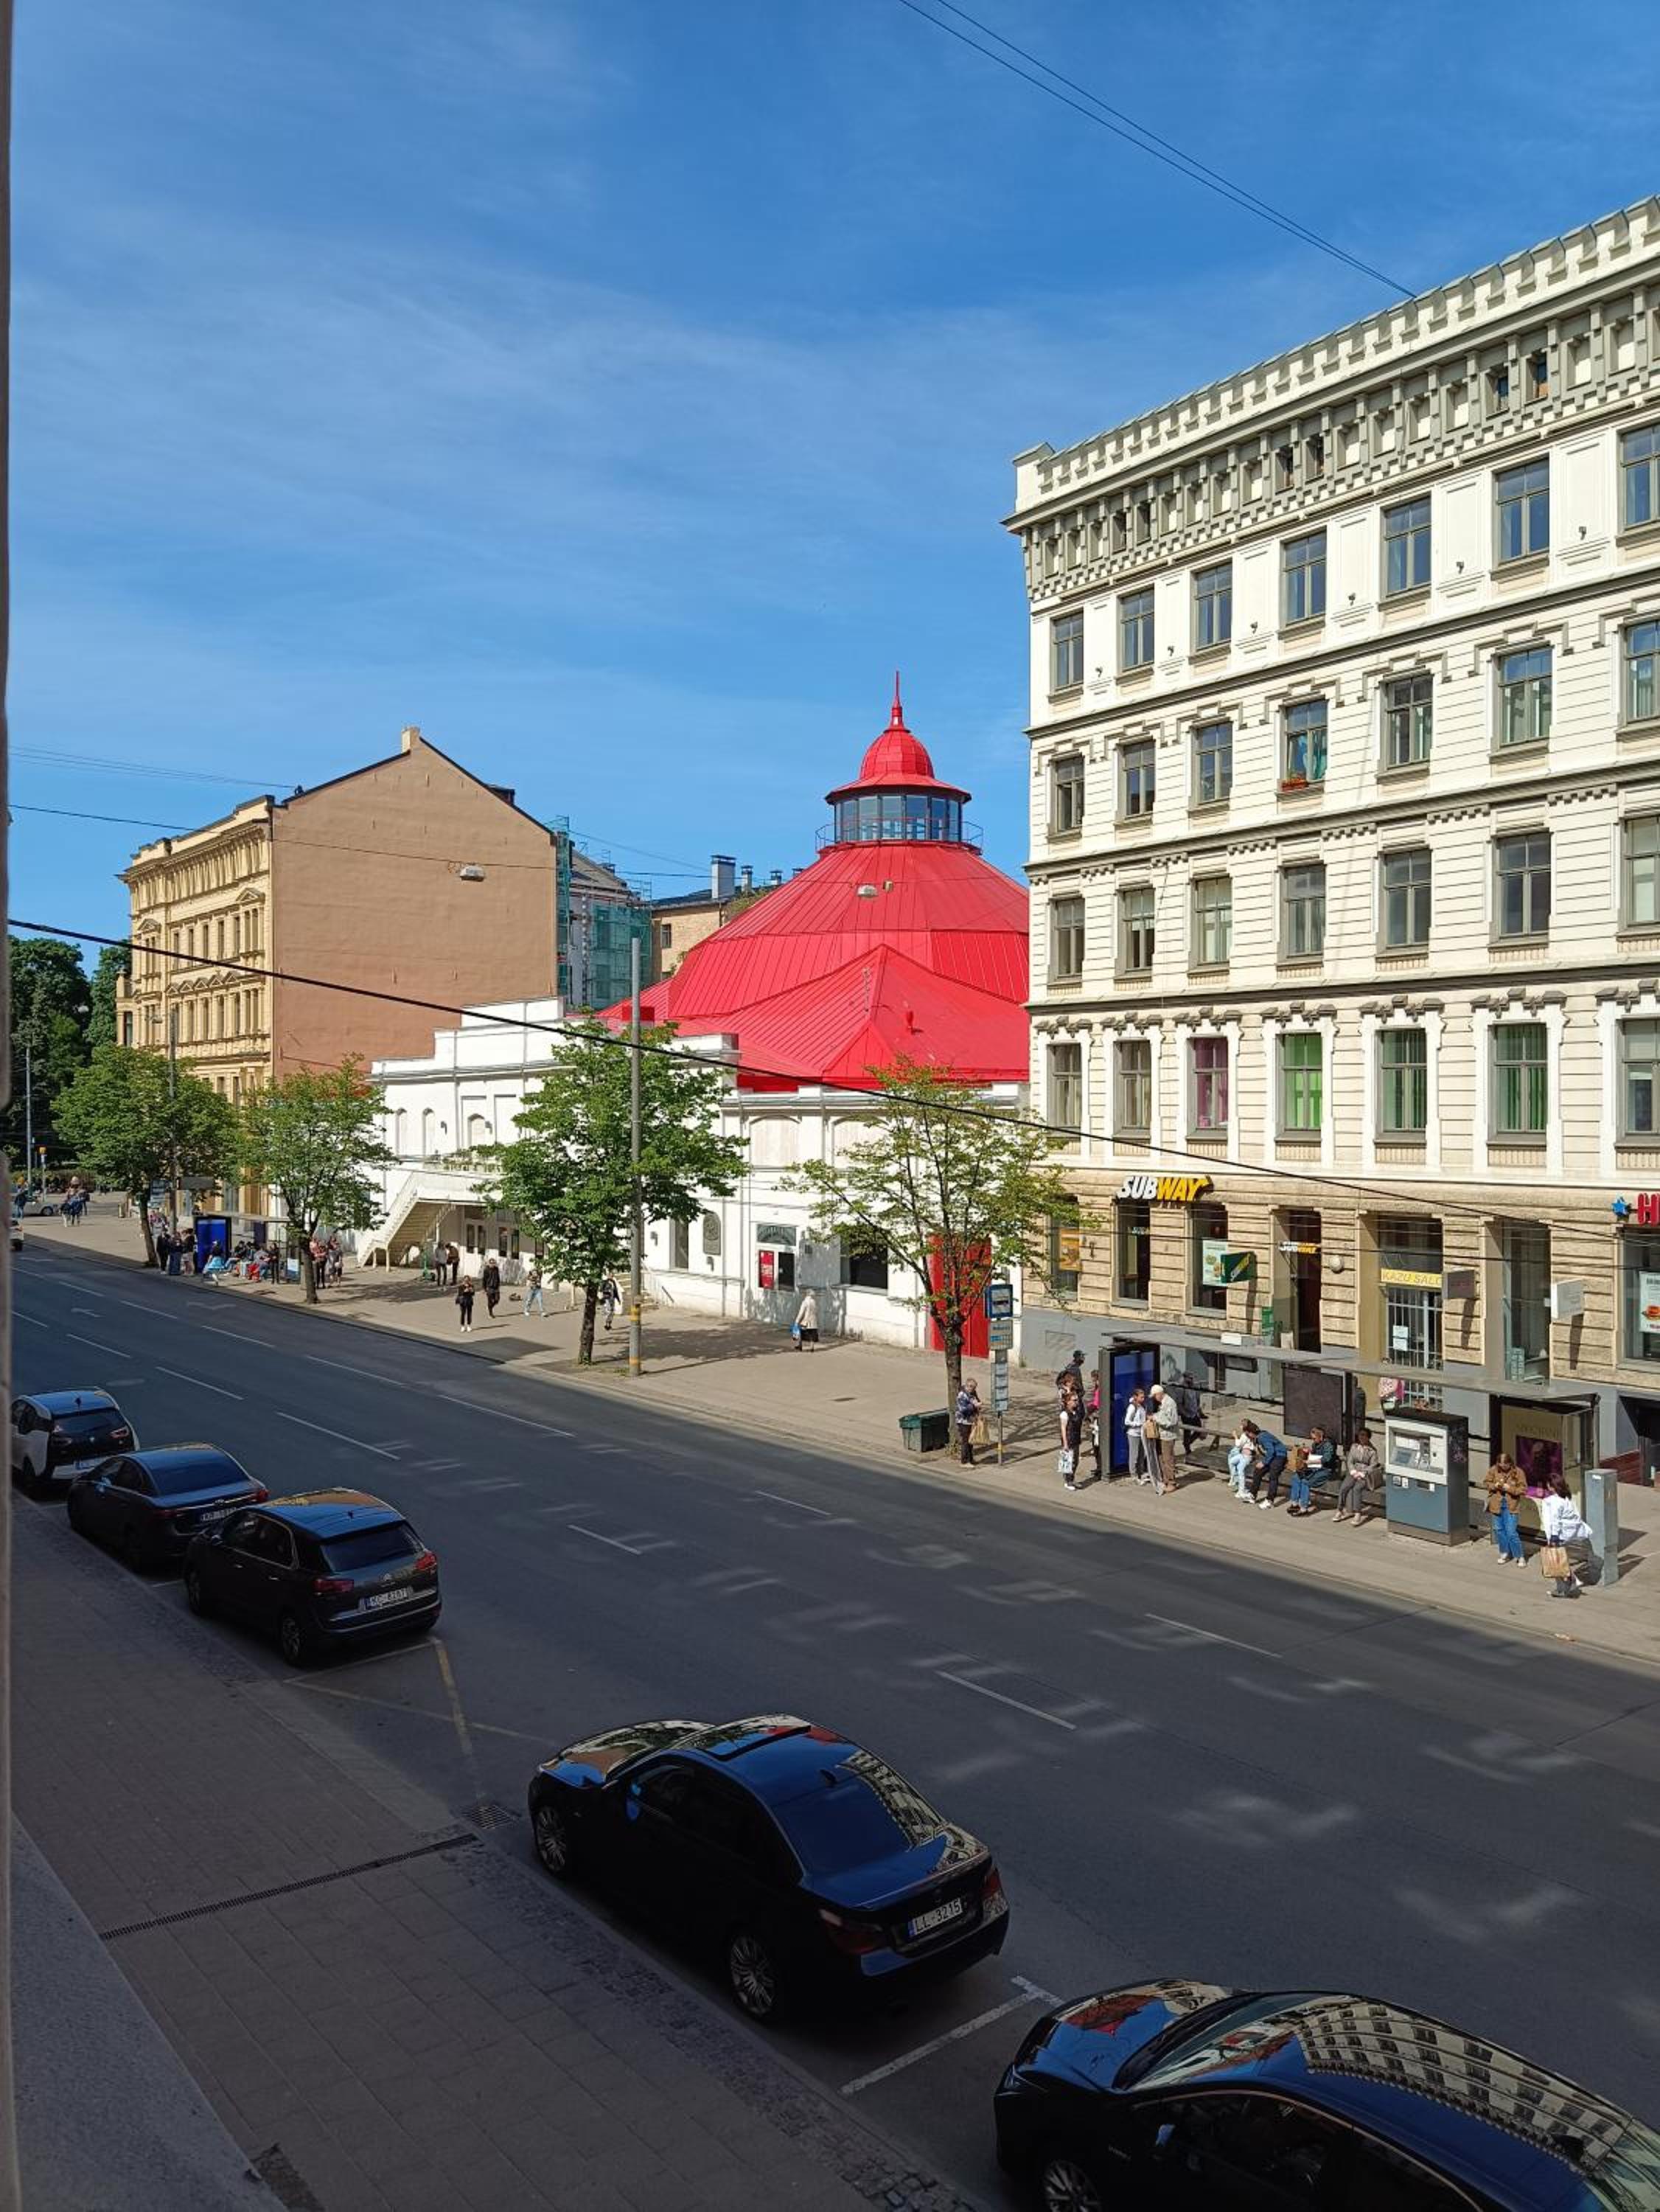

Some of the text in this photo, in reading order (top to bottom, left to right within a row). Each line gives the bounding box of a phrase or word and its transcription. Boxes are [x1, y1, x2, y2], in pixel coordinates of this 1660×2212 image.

[1116, 1176, 1210, 1201] SUBWAY
[1279, 1241, 1322, 1254] SUBWAY
[915, 1899, 960, 1932] LL-3215
